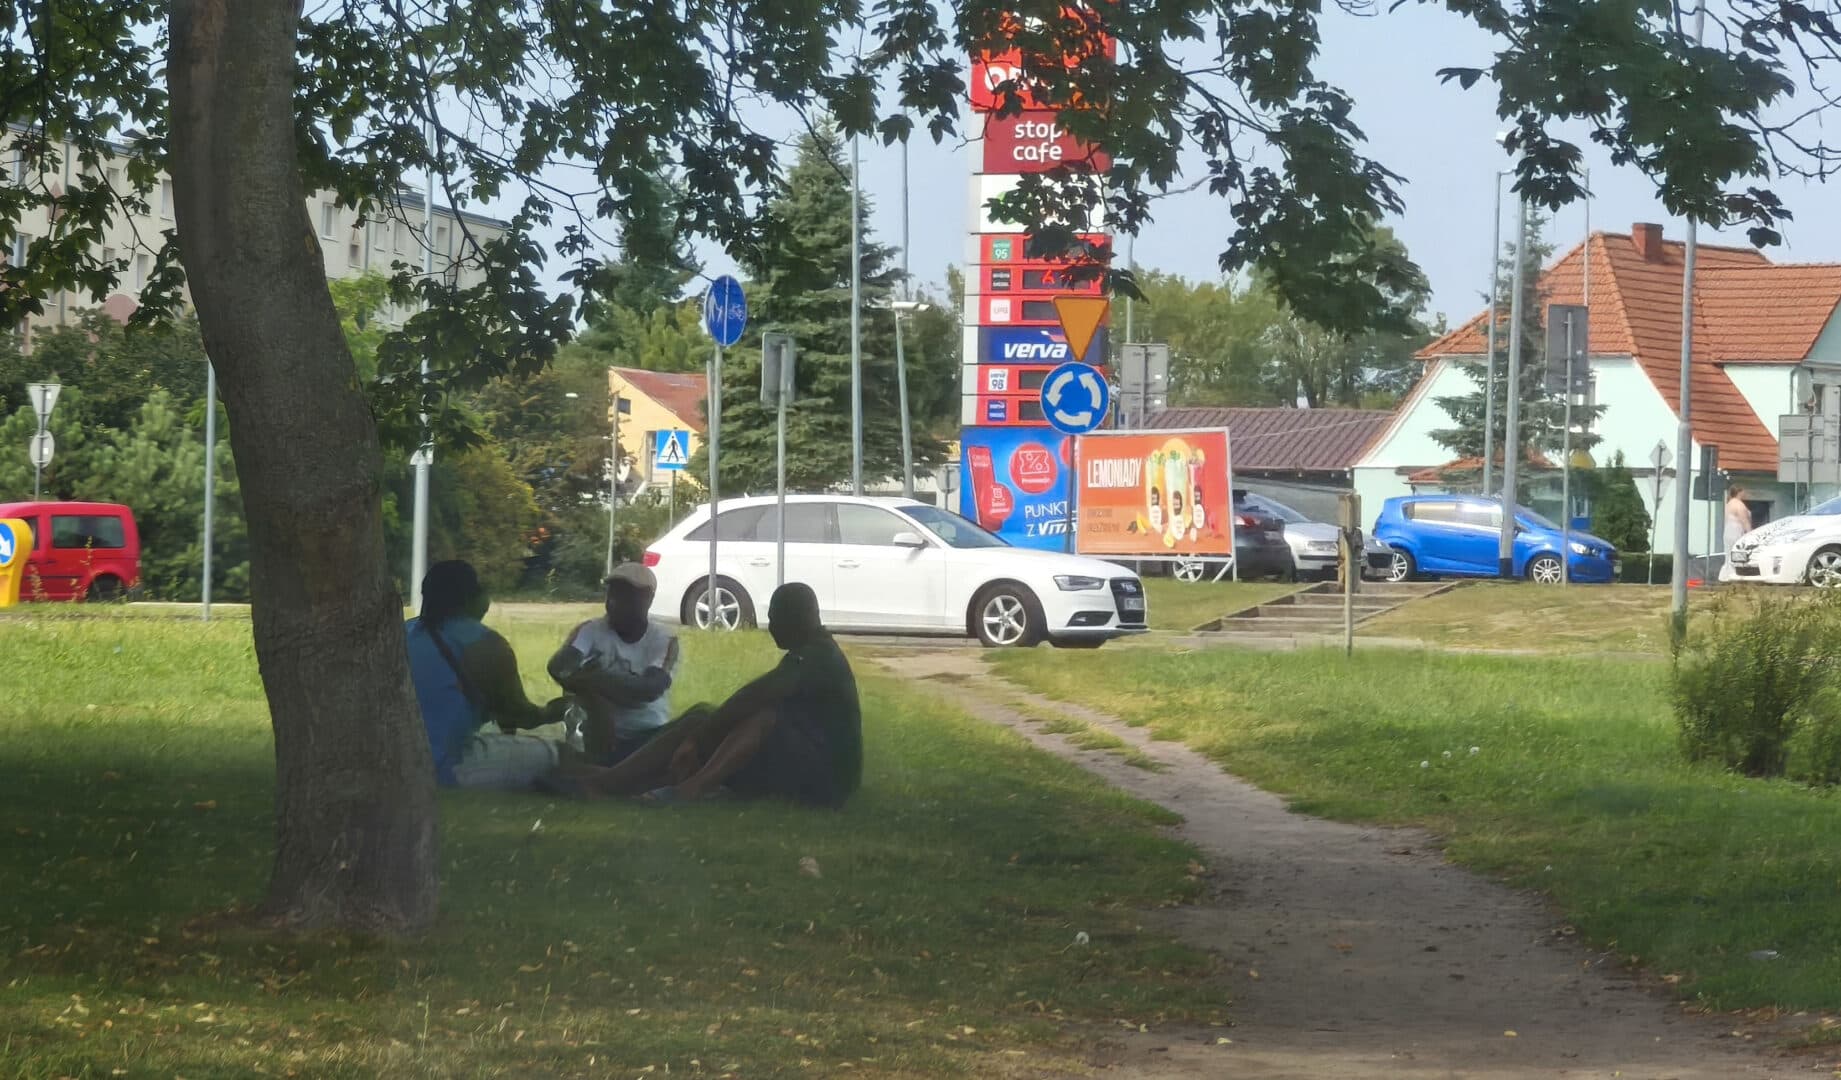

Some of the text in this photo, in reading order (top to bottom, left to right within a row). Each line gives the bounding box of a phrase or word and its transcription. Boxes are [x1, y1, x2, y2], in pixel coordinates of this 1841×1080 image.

[1014, 120, 1063, 144] stop
[1013, 142, 1063, 163] cafe
[994, 248, 1009, 260] 95
[1004, 343, 1068, 359] verva
[1087, 457, 1142, 489] LEMONIADY
